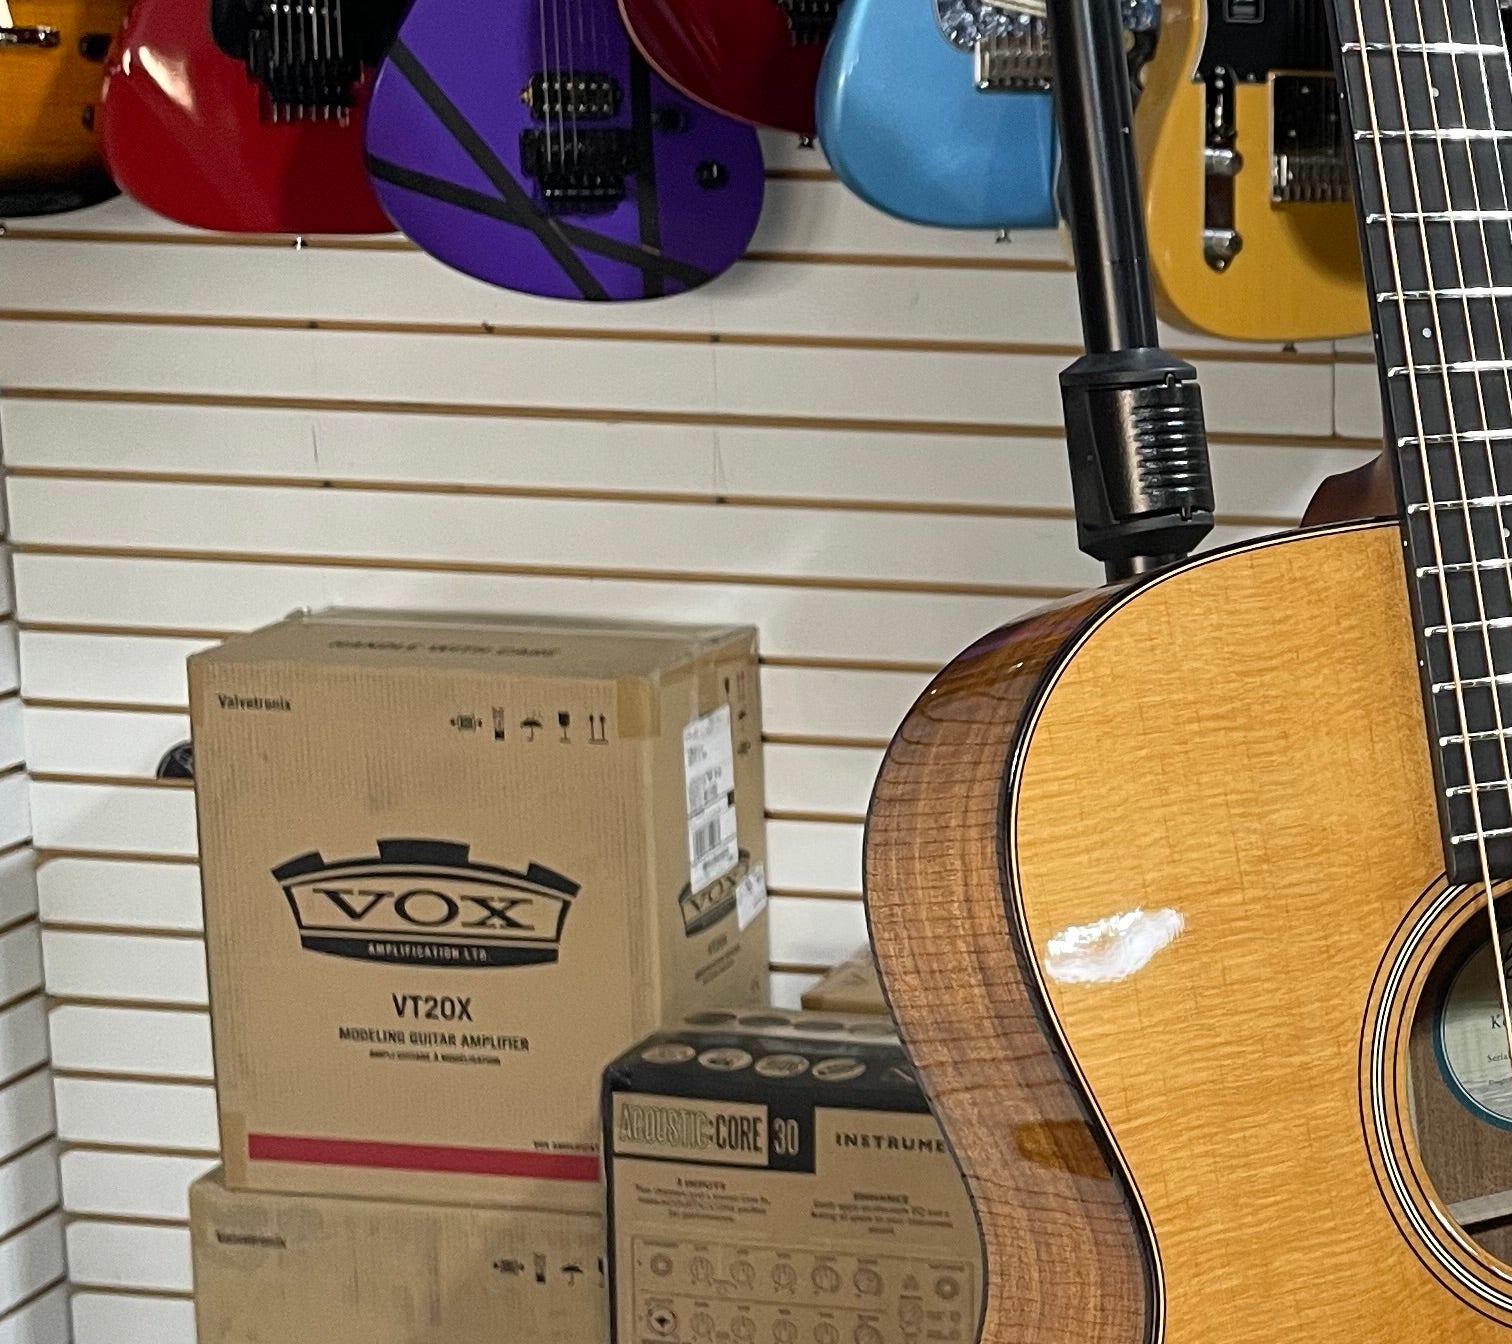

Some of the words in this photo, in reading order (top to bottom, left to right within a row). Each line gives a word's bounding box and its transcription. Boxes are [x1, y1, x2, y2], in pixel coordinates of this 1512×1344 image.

[312, 888, 536, 931] VOX
[367, 940, 460, 960] AMPLIFICATION
[391, 991, 474, 1022] VT20X
[338, 1026, 405, 1045] MODELING
[409, 1031, 457, 1046] GUITAR
[461, 1034, 530, 1053] AMPLIFIER
[772, 1117, 800, 1156] 30
